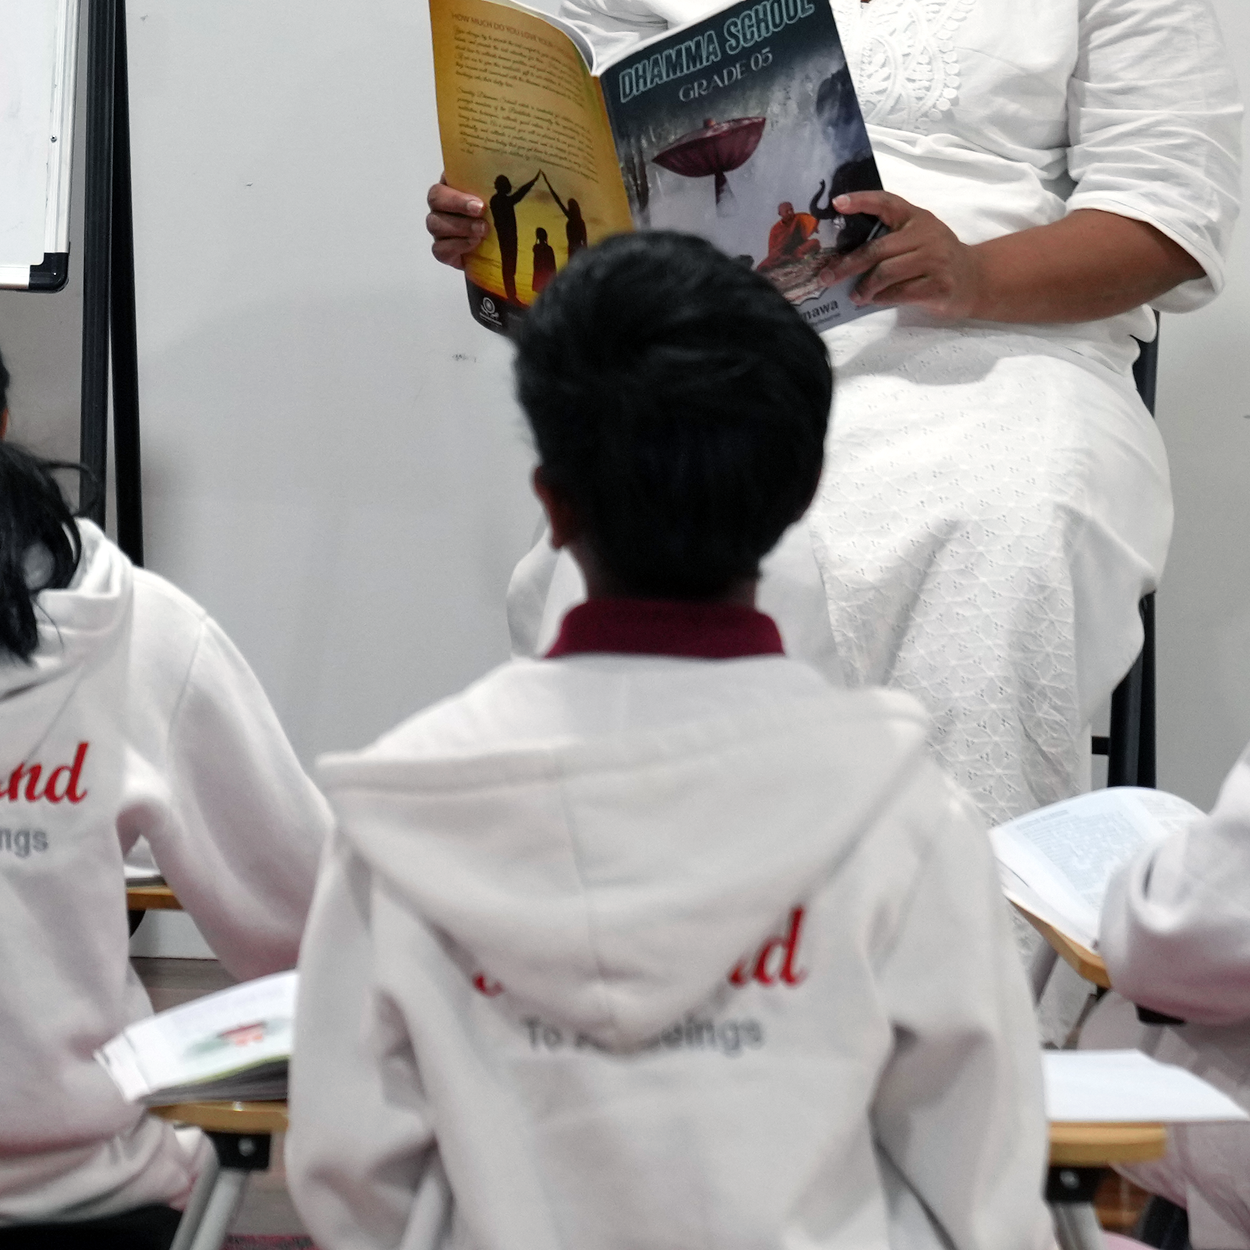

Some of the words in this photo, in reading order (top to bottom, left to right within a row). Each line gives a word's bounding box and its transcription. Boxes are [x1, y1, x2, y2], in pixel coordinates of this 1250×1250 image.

[618, 29, 721, 104] DHAMMA
[678, 58, 747, 102] GRADE
[749, 46, 774, 73] 05
